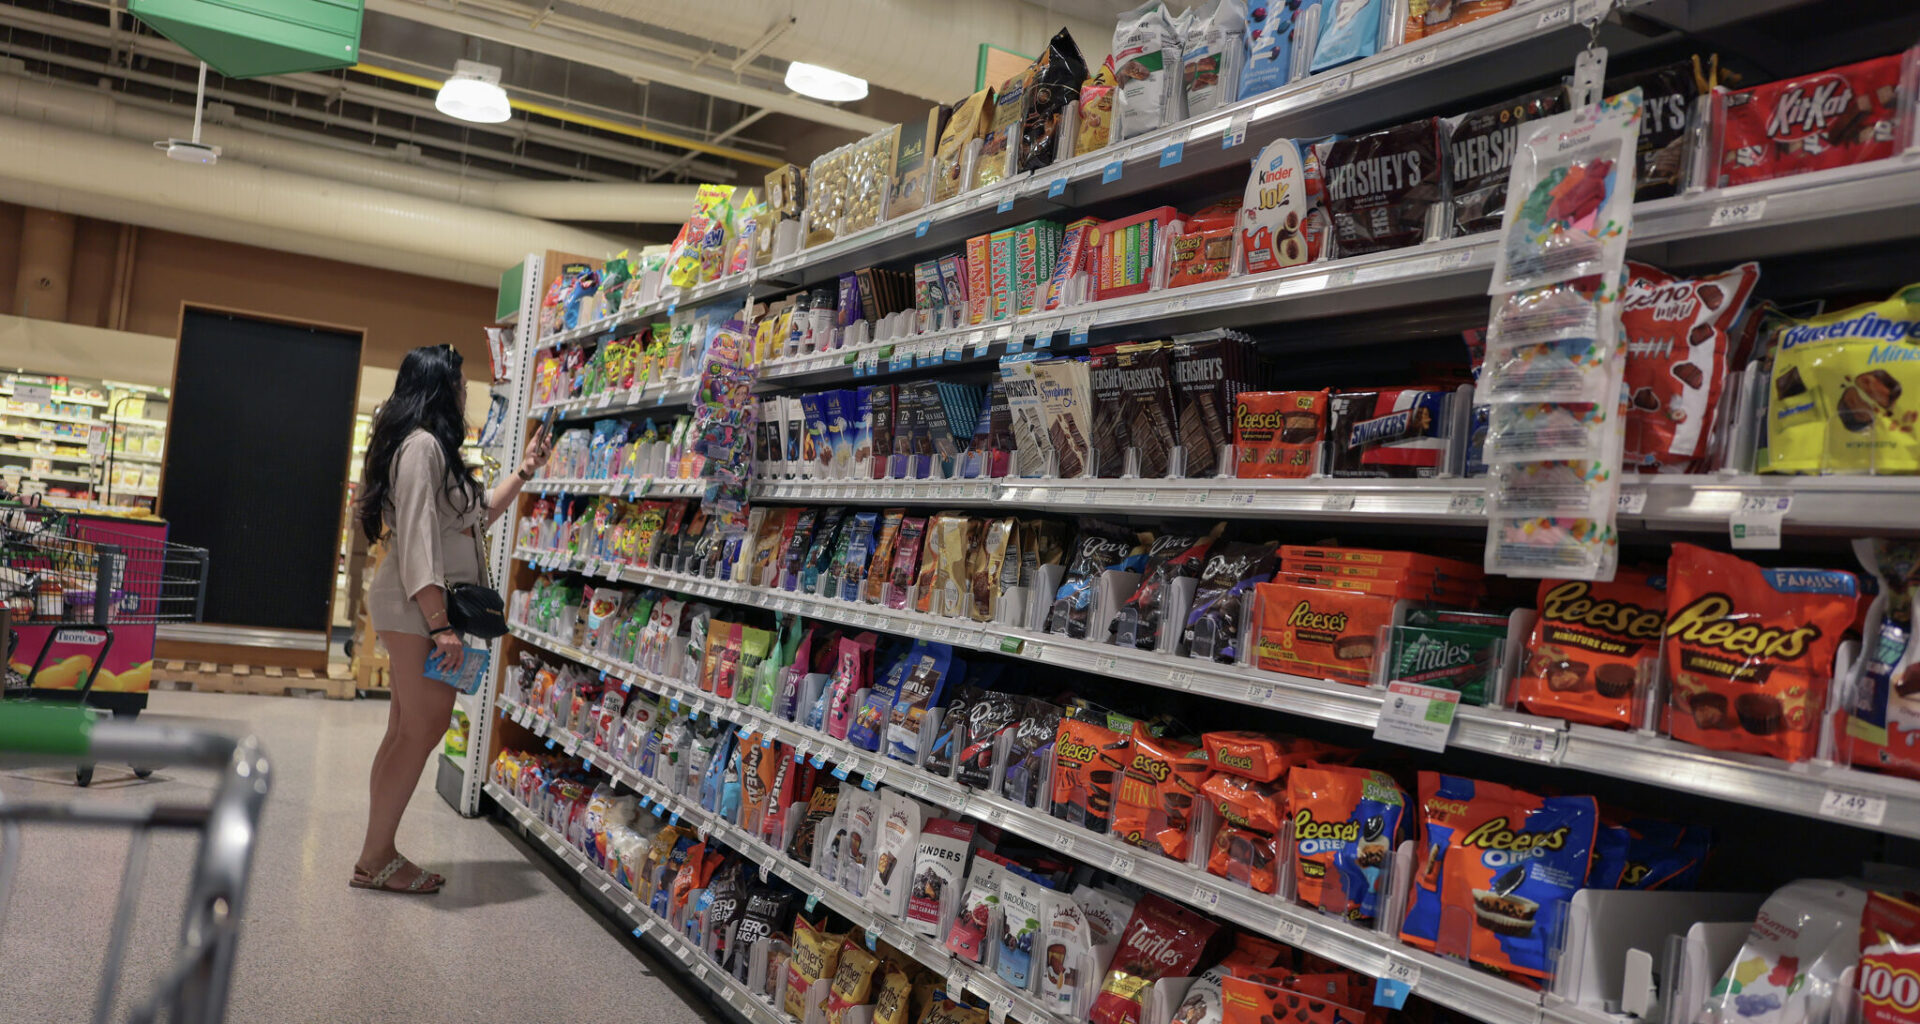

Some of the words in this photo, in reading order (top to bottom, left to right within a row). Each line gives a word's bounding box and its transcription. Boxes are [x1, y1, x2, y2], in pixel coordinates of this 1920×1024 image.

[1329, 150, 1422, 201] HERSHEY'S
[1121, 366, 1166, 391] HERSHEY'S
[1175, 357, 1223, 384] HERSHEY'S
[1004, 379, 1038, 398] HERSHEY'S
[1236, 403, 1282, 430] Reese's
[1351, 413, 1409, 445] SNICKERS
[1082, 536, 1128, 557] Dove
[1149, 534, 1191, 557] Dove
[1775, 573, 1840, 587] FAMILY
[1287, 600, 1348, 632] Reese's
[1667, 596, 1816, 657] Reese's
[1552, 631, 1600, 650] MINIATURE
[1600, 643, 1627, 653] CUPS
[1412, 642, 1470, 672] Andes
[829, 652, 853, 720] UNREAL
[1056, 732, 1098, 762] Reese's
[1217, 747, 1253, 769] Reese's
[747, 743, 764, 805] UNREAL
[768, 754, 791, 816] UNREAL
[1427, 799, 1468, 816] SNACK
[1832, 794, 1867, 809] 7.49
[1003, 891, 1037, 914] BROOKSIDE
[739, 919, 772, 937] ZERO
[1127, 920, 1183, 967] Turtles
[1388, 962, 1410, 977] 7.49
